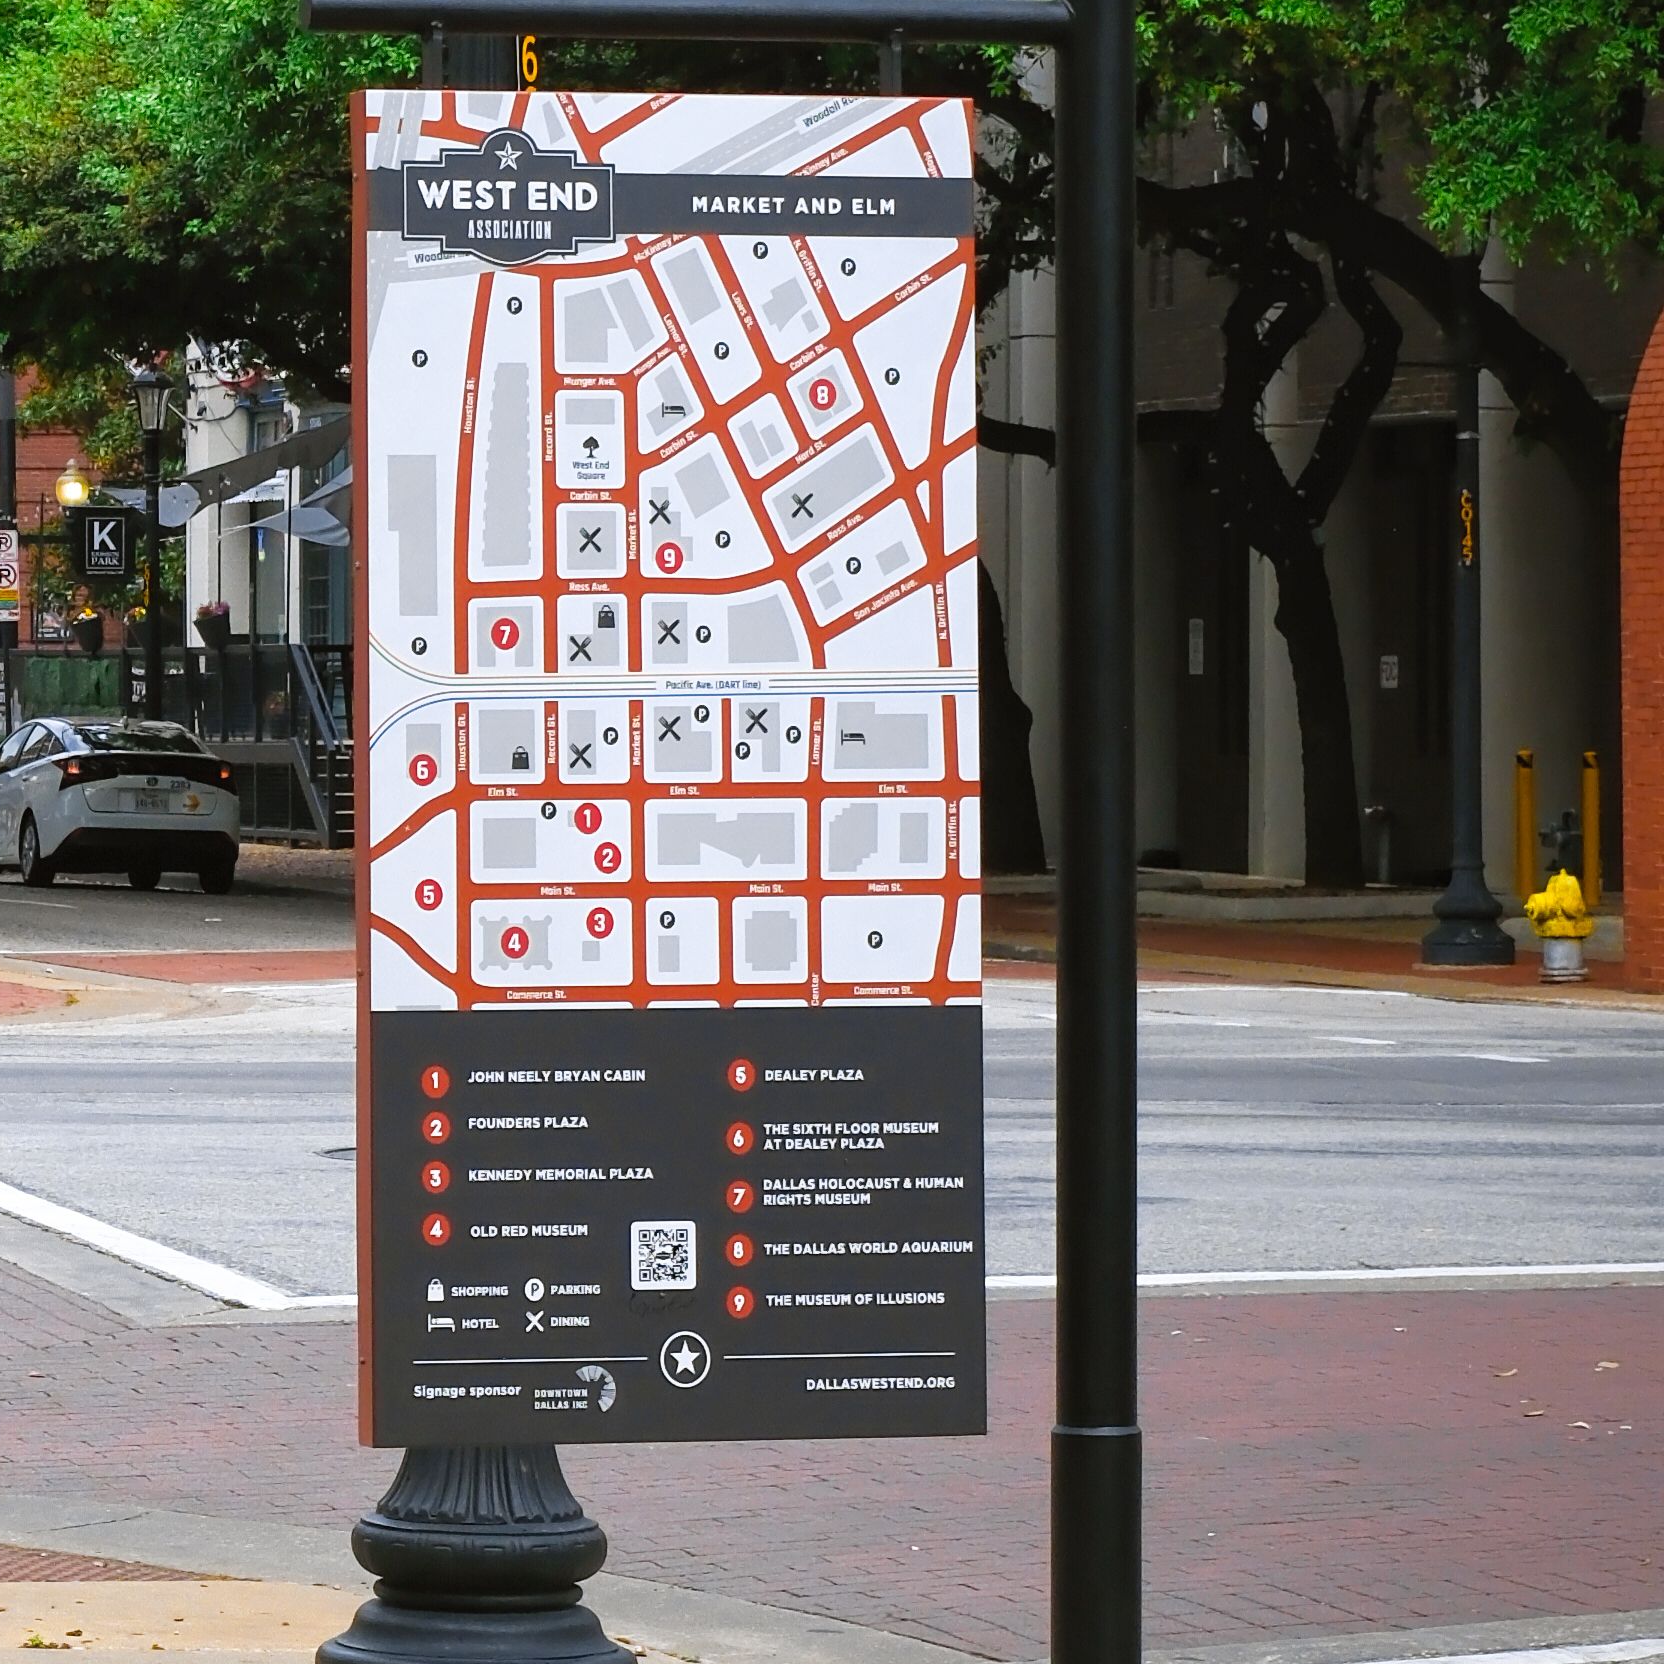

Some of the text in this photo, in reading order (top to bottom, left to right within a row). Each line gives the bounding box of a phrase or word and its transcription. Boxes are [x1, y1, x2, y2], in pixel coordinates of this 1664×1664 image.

[803, 101, 841, 128] Woodall
[417, 179, 598, 212] WEST END
[692, 196, 895, 216] MARKET AND ELM
[467, 219, 552, 240] ASSOCIATION
[894, 273, 932, 301] Corbin St.
[731, 291, 754, 330] Laws St.
[816, 384, 829, 405] 8
[464, 391, 475, 434] Houston
[544, 426, 553, 462] Record
[659, 430, 698, 458] Corbin St.
[572, 461, 609, 470] West End
[599, 491, 612, 501] St.
[93, 521, 117, 551] K
[827, 514, 864, 541] Ross Ave.
[91, 557, 119, 565] PARK
[663, 548, 676, 568] 9
[853, 579, 918, 620] San Jacinto Ave.
[500, 625, 511, 645] 7
[665, 680, 693, 690] Pacific
[696, 680, 713, 690] Ave.
[715, 680, 740, 690] (DART
[632, 729, 640, 766] Market
[812, 732, 821, 765] Lamar
[416, 760, 429, 780] 6
[488, 787, 518, 796] Elm St.
[878, 784, 909, 794] Elm St.
[583, 809, 591, 828] 1
[948, 815, 957, 848] Griffin
[602, 848, 613, 867] 2
[423, 885, 435, 905] 5
[540, 886, 576, 896] Main St.
[749, 884, 784, 893] Main St.
[594, 913, 606, 932] 3
[507, 933, 521, 952] 4
[507, 990, 567, 1000] Commerce St.
[811, 972, 819, 1007] Center
[853, 985, 913, 995] Commerce St.
[431, 1069, 646, 1089] 1 JOHN NEELY BRYAN CABIN
[735, 1066, 864, 1084] 5 DEALEY PLAZA
[430, 1117, 588, 1137] 2 FOUNDERS PLAZA
[763, 1122, 939, 1135] THE SIXTH FLOOR MUSEUM
[733, 1129, 745, 1147] 6
[763, 1137, 885, 1150] AT DEALEY PLAZA
[429, 1167, 654, 1187] 3 KENNEDY MEMORIAL PLAZA
[763, 1176, 964, 1191] DALLAS HOLOCAUST & HUMAN
[733, 1188, 745, 1206] 7
[763, 1193, 871, 1206] RIGHTS MUSEUM
[429, 1220, 588, 1238] 4 OLD RED MUSEUM
[733, 1241, 973, 1259] 8 THE DALLAS WORLD AQUARIUM
[451, 1285, 509, 1297] SHOPPING
[550, 1285, 601, 1295] PARKING
[733, 1292, 945, 1311] 9 THE MUSEUM OF ILLUSIONS
[461, 1318, 499, 1329] HOTEL
[550, 1316, 590, 1327] DINING
[413, 1385, 522, 1399] Signage sponsor
[534, 1388, 588, 1398] DOWNTOWN
[806, 1376, 956, 1391] DALLASWESTEND.ORG
[534, 1400, 569, 1409] DALLAS
